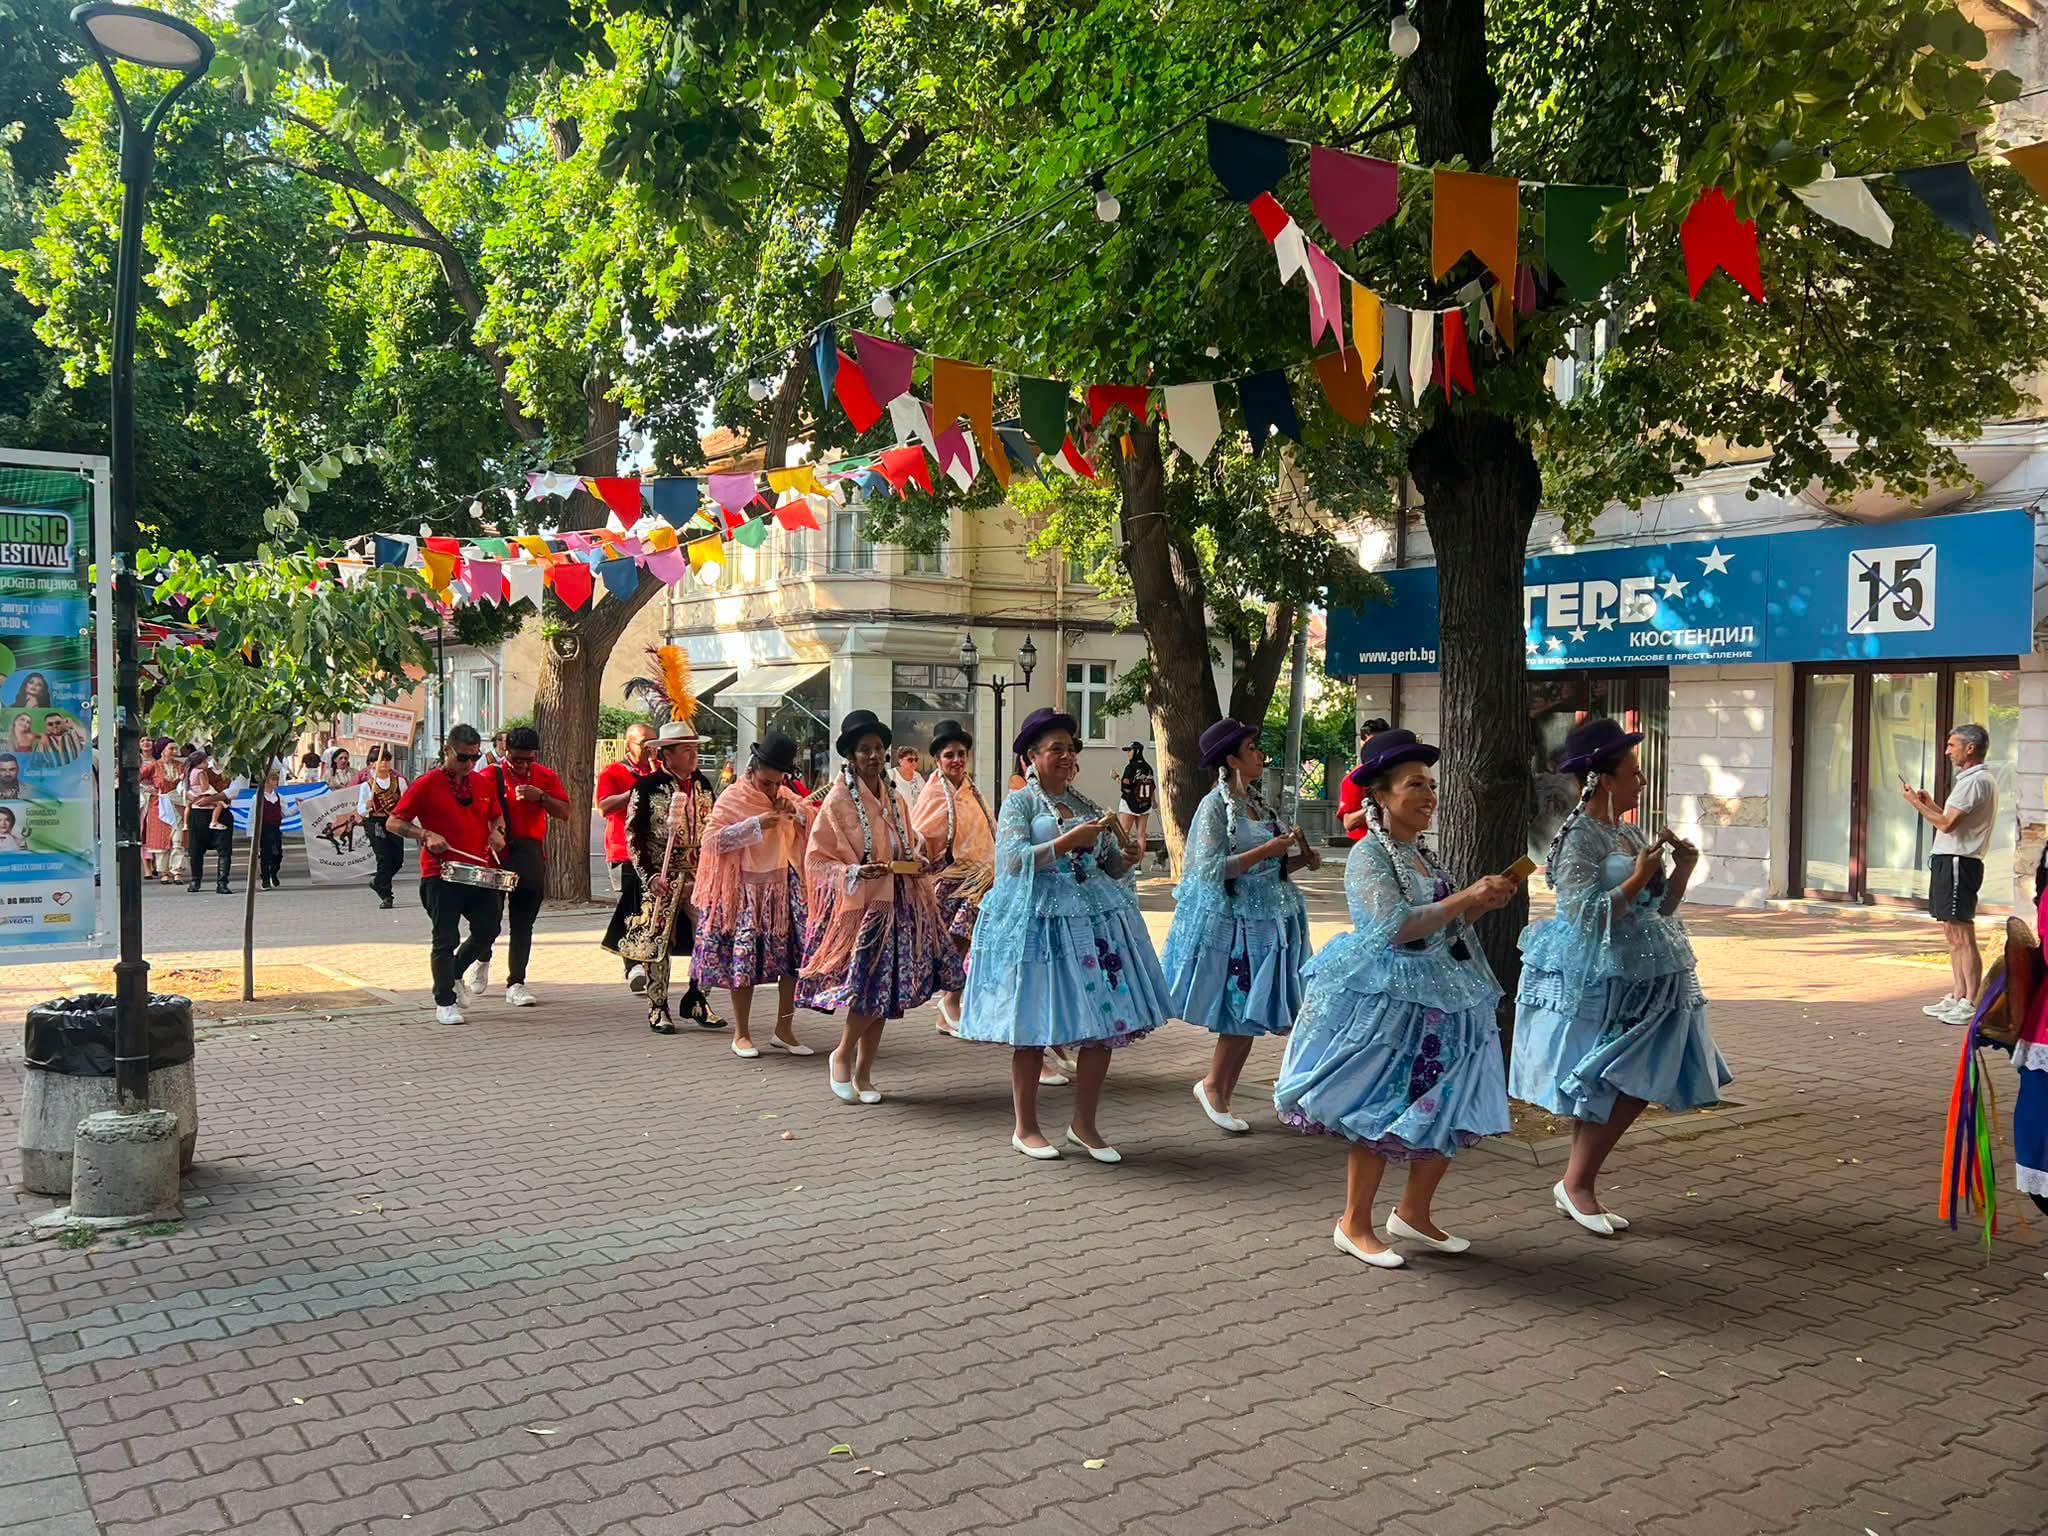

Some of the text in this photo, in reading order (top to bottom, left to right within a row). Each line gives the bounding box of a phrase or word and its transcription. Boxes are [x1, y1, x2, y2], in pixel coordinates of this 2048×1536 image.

[1858, 558, 1924, 622] 15
[0, 616, 21, 629] 0:00
[1629, 626, 1755, 649] КЮСТЕНДИЛ
[1359, 646, 1436, 665] www.gerb.bg
[1545, 656, 1608, 665] ПРОДАВАНЕТО
[1608, 655, 1622, 663] НА
[1623, 653, 1665, 662] ГЛАСОВЕ
[1666, 653, 1673, 661] Е
[1674, 650, 1753, 661] ПРЕСТЪПЛЕНИЕ
